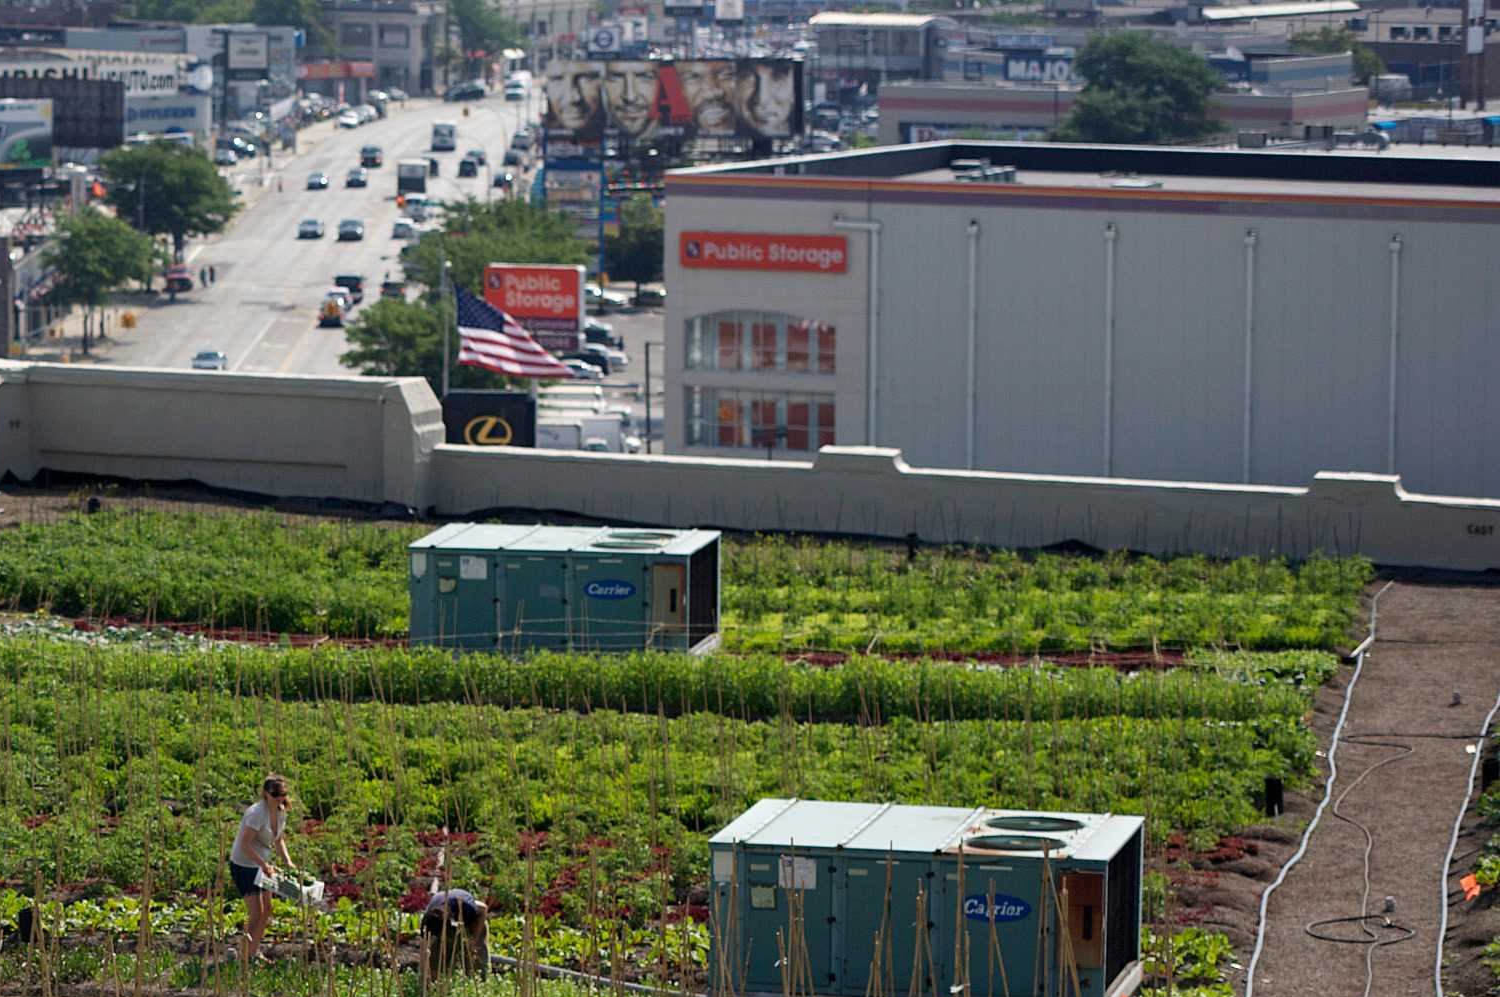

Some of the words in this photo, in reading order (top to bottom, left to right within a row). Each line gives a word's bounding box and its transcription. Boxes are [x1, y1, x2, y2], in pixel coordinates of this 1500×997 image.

[703, 241, 764, 261] Public
[768, 244, 843, 269] Storage
[504, 273, 561, 291] Public
[505, 292, 575, 313] Storage
[587, 583, 631, 595] Carrier
